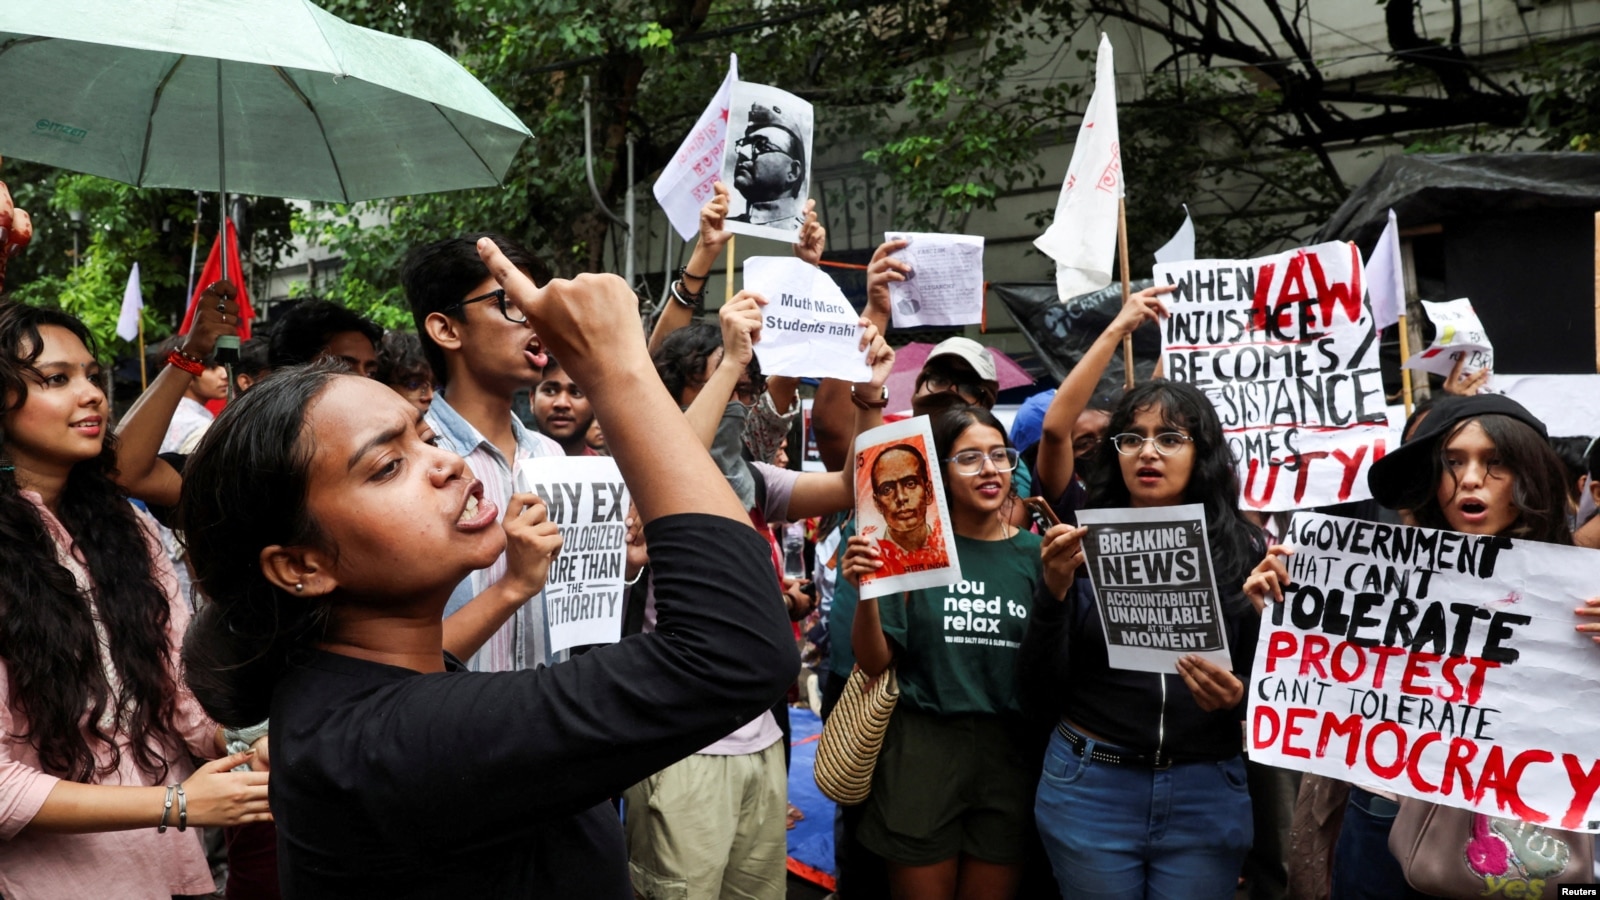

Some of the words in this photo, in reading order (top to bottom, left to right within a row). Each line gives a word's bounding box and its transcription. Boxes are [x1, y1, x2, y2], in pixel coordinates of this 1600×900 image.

[1166, 266, 1255, 303] WHEN
[781, 293, 812, 311] Muth
[814, 300, 845, 314] Maro
[766, 316, 825, 334] Students
[829, 325, 856, 337] nahi
[1167, 298, 1326, 345] INJUSTICE
[1168, 338, 1340, 384] BECOMES
[1201, 367, 1387, 429] ESISTANCE
[1228, 428, 1302, 472] OMES
[536, 483, 582, 524] MY
[591, 483, 625, 523] EX
[558, 525, 624, 554] POLOGIZED
[1099, 527, 1187, 554] BREAKING
[1287, 520, 1297, 545] A
[1299, 519, 1513, 579] GOVERNMENT
[545, 557, 577, 585] ORE
[582, 553, 622, 580] THAN
[927, 561, 950, 570] INDIA
[1101, 550, 1197, 585] NEWS
[1344, 562, 1442, 599] CAN'T
[567, 583, 583, 594] THE
[1106, 591, 1208, 607] ACCOUNTABILITY
[548, 592, 618, 627] UTHORITY
[943, 596, 1001, 615] need
[1007, 599, 1027, 619] to
[943, 611, 1000, 633] relax
[1108, 606, 1212, 625] UNAVAILABLE
[1271, 582, 1532, 665] TOLERATE
[1121, 631, 1207, 648] MOMENT
[1265, 631, 1501, 705] PROTEST
[1258, 676, 1332, 705] CAN'T
[1347, 687, 1502, 740] TOLERATE
[1253, 705, 1600, 830] DEMOCRACY
